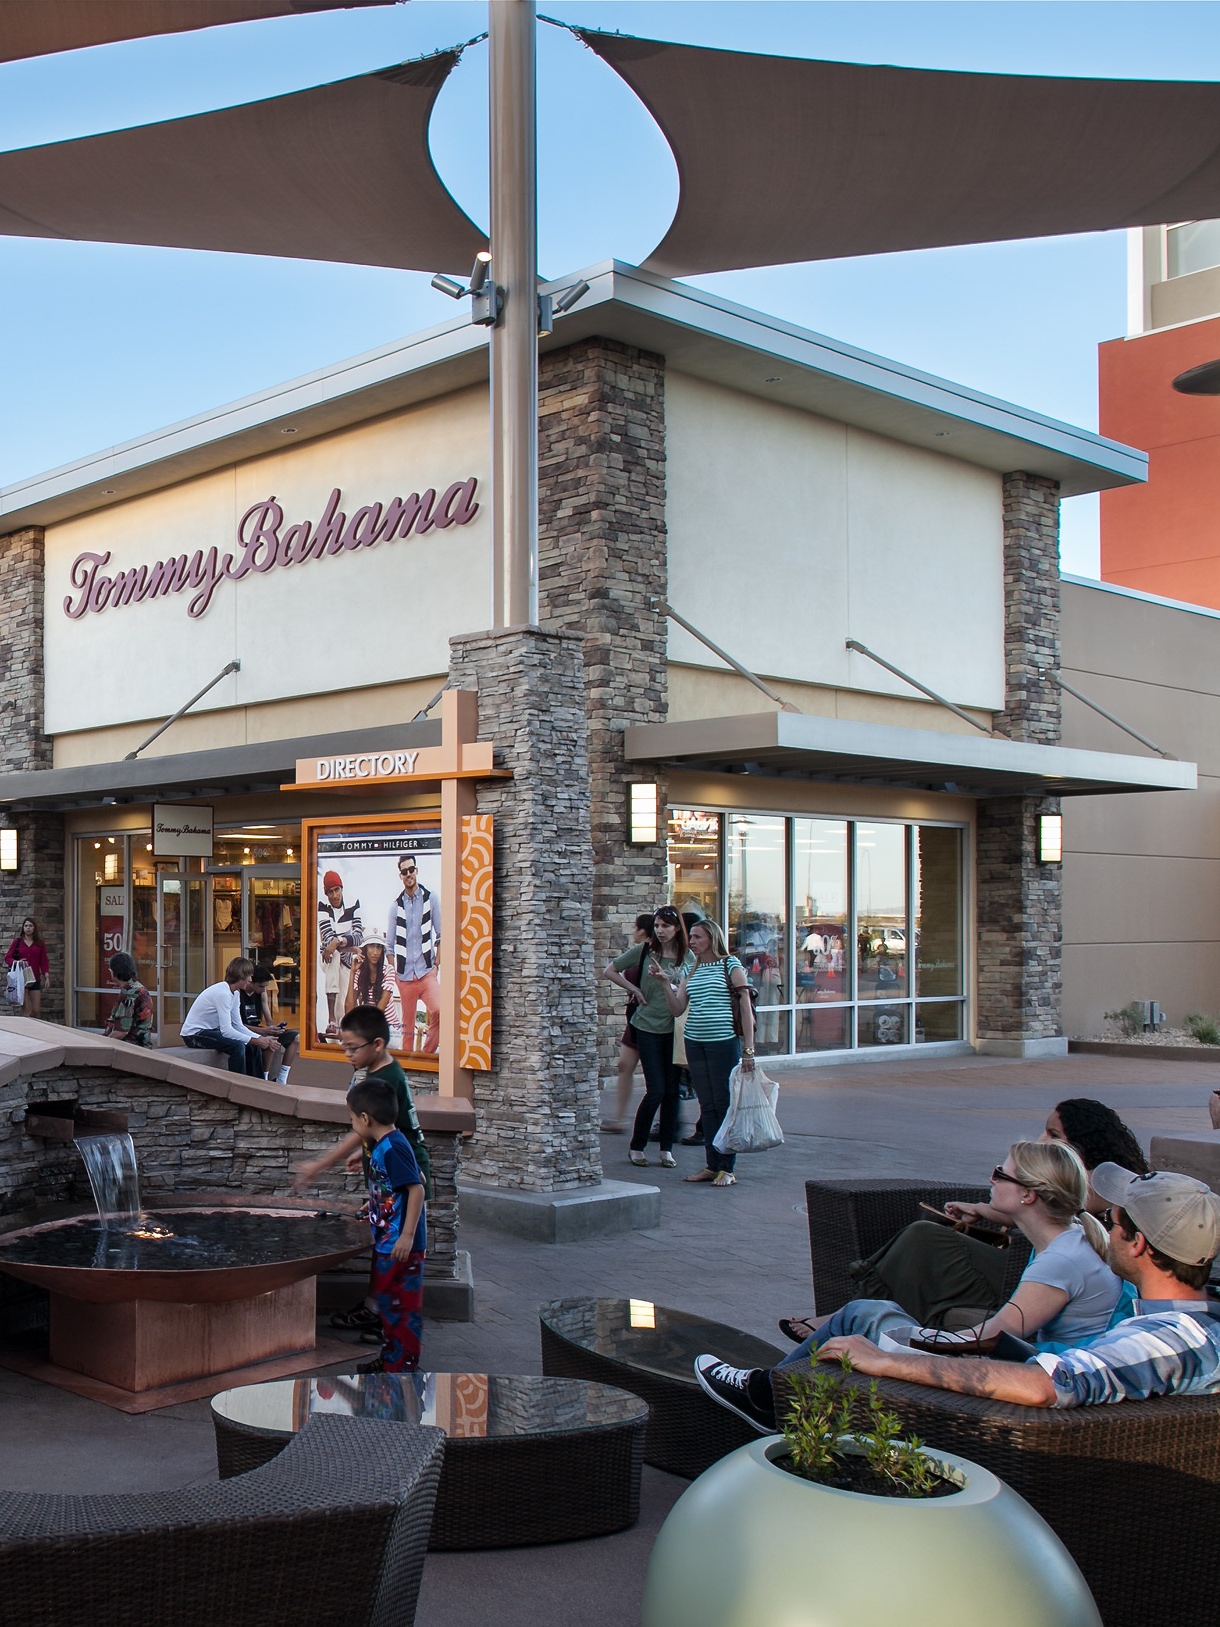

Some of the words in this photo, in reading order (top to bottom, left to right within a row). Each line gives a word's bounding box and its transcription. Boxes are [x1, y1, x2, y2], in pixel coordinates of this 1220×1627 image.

[63, 546, 218, 619] Tommy
[221, 476, 481, 581] Bahama
[316, 751, 420, 781] DIRECTORY
[156, 823, 181, 837] Tommy
[180, 825, 211, 835] Bahama
[341, 842, 373, 850] TOMMY
[383, 840, 418, 849] HILFIGER
[105, 896, 124, 906] SAL
